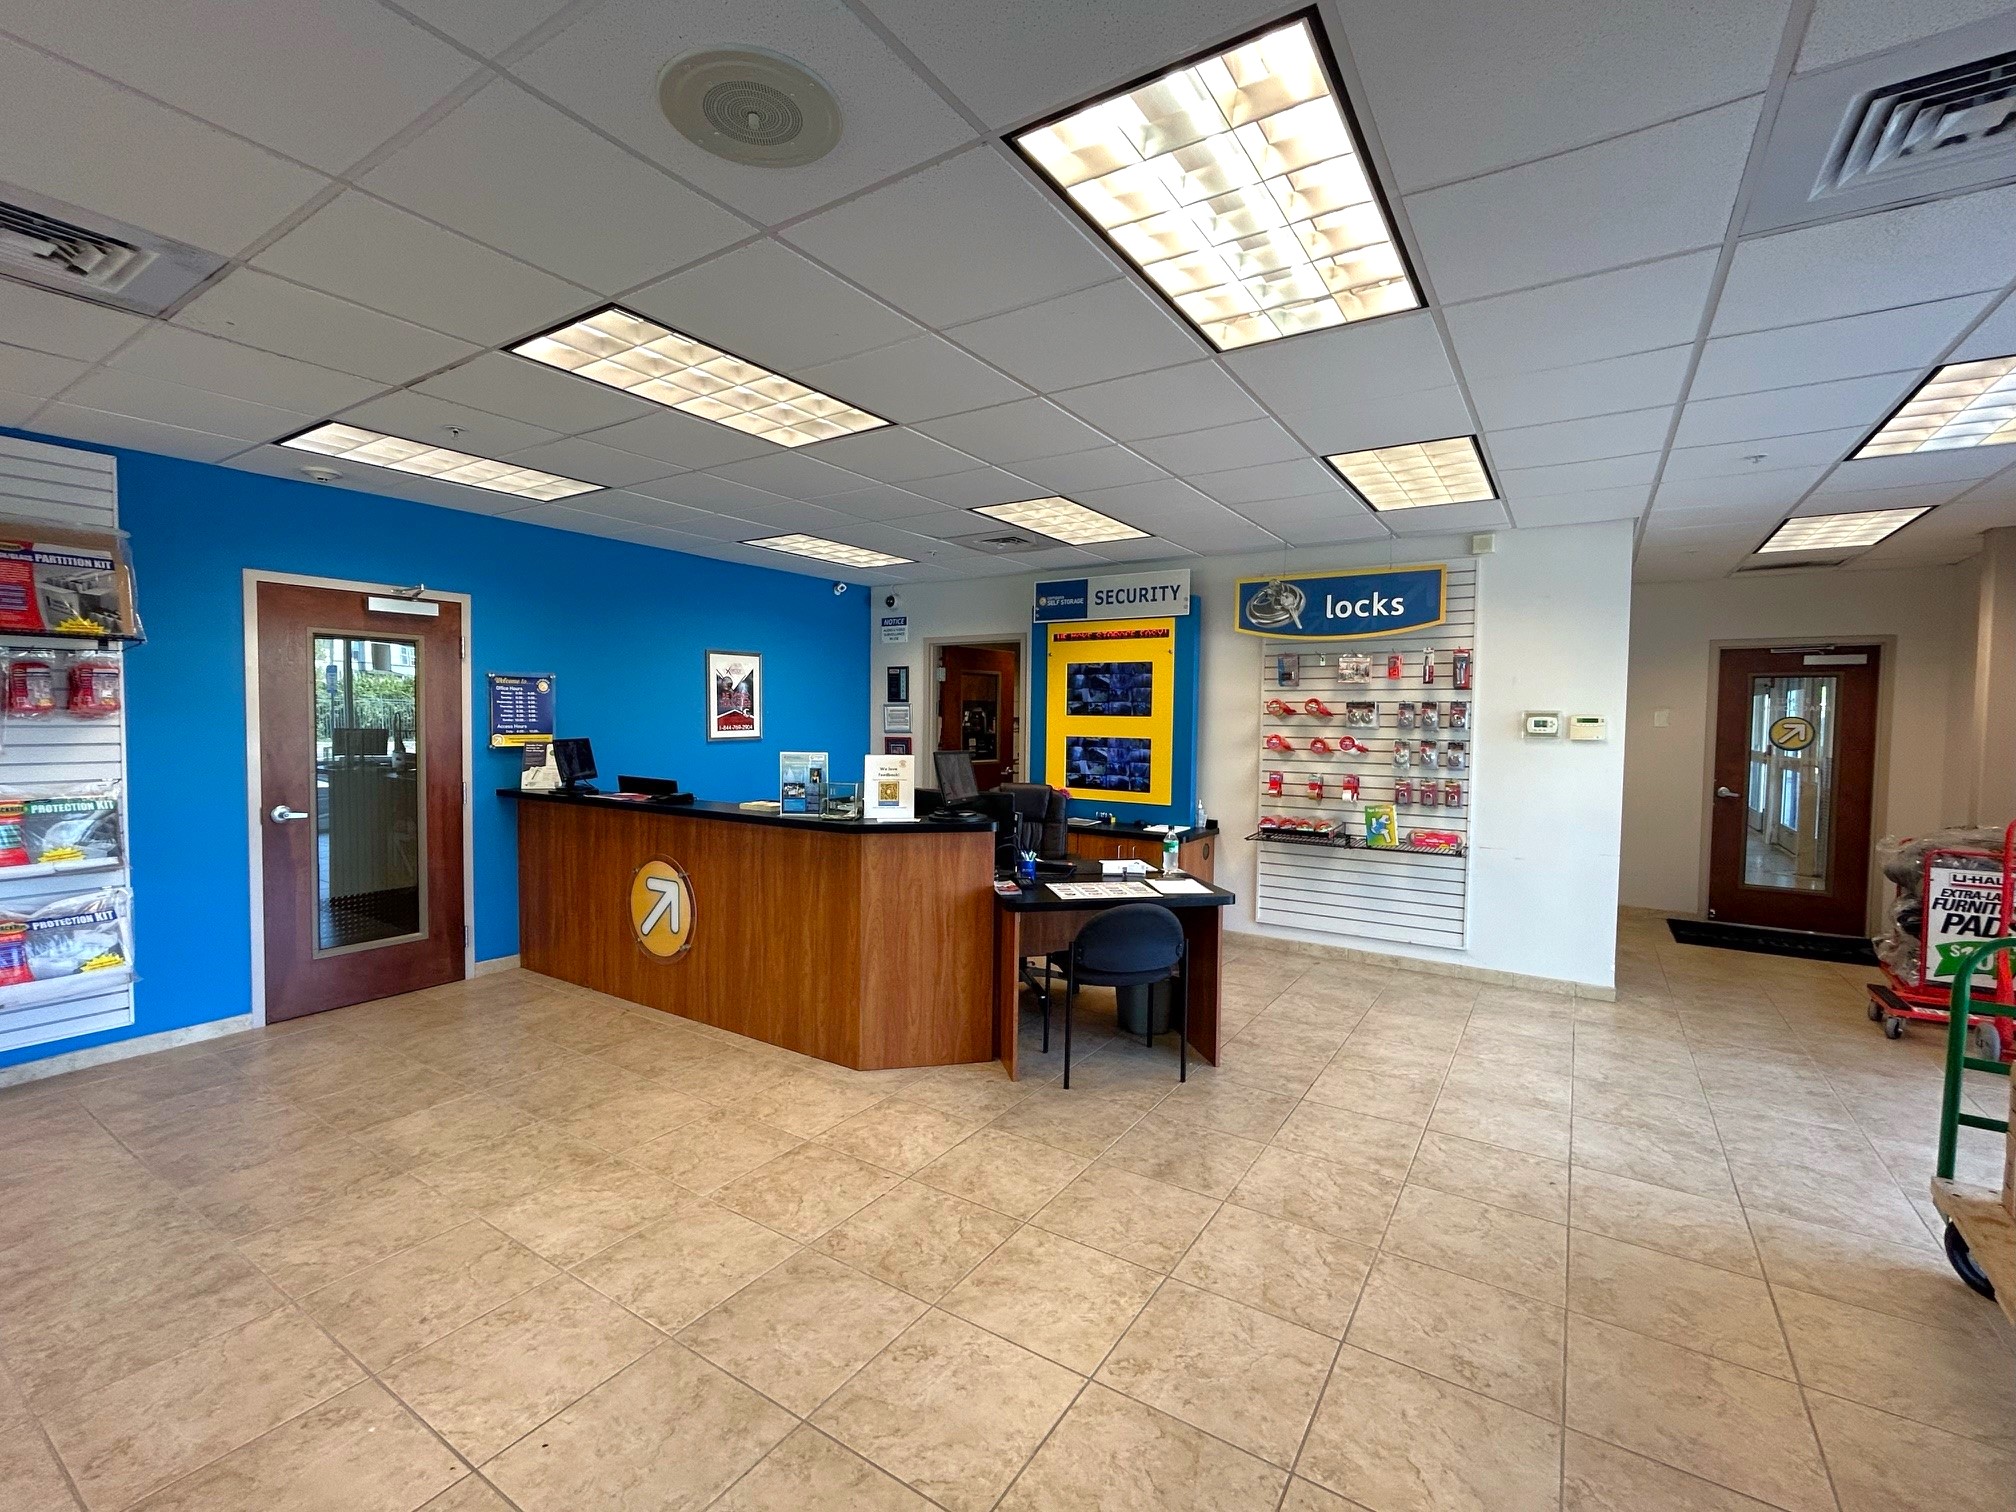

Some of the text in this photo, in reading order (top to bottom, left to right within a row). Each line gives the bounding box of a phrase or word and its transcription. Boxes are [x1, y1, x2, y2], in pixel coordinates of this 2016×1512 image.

[34, 553, 93, 567] PARTITION
[94, 559, 111, 569] KIT
[1094, 584, 1181, 605] SECURITY
[1326, 591, 1405, 619] locks
[31, 800, 114, 813] PROTECTION KIT
[1941, 888, 2002, 902] EXTRA-LA
[1932, 897, 2003, 915] FURNIT
[33, 910, 113, 930] PROTECTION KIT
[1941, 912, 2012, 938] PAD
